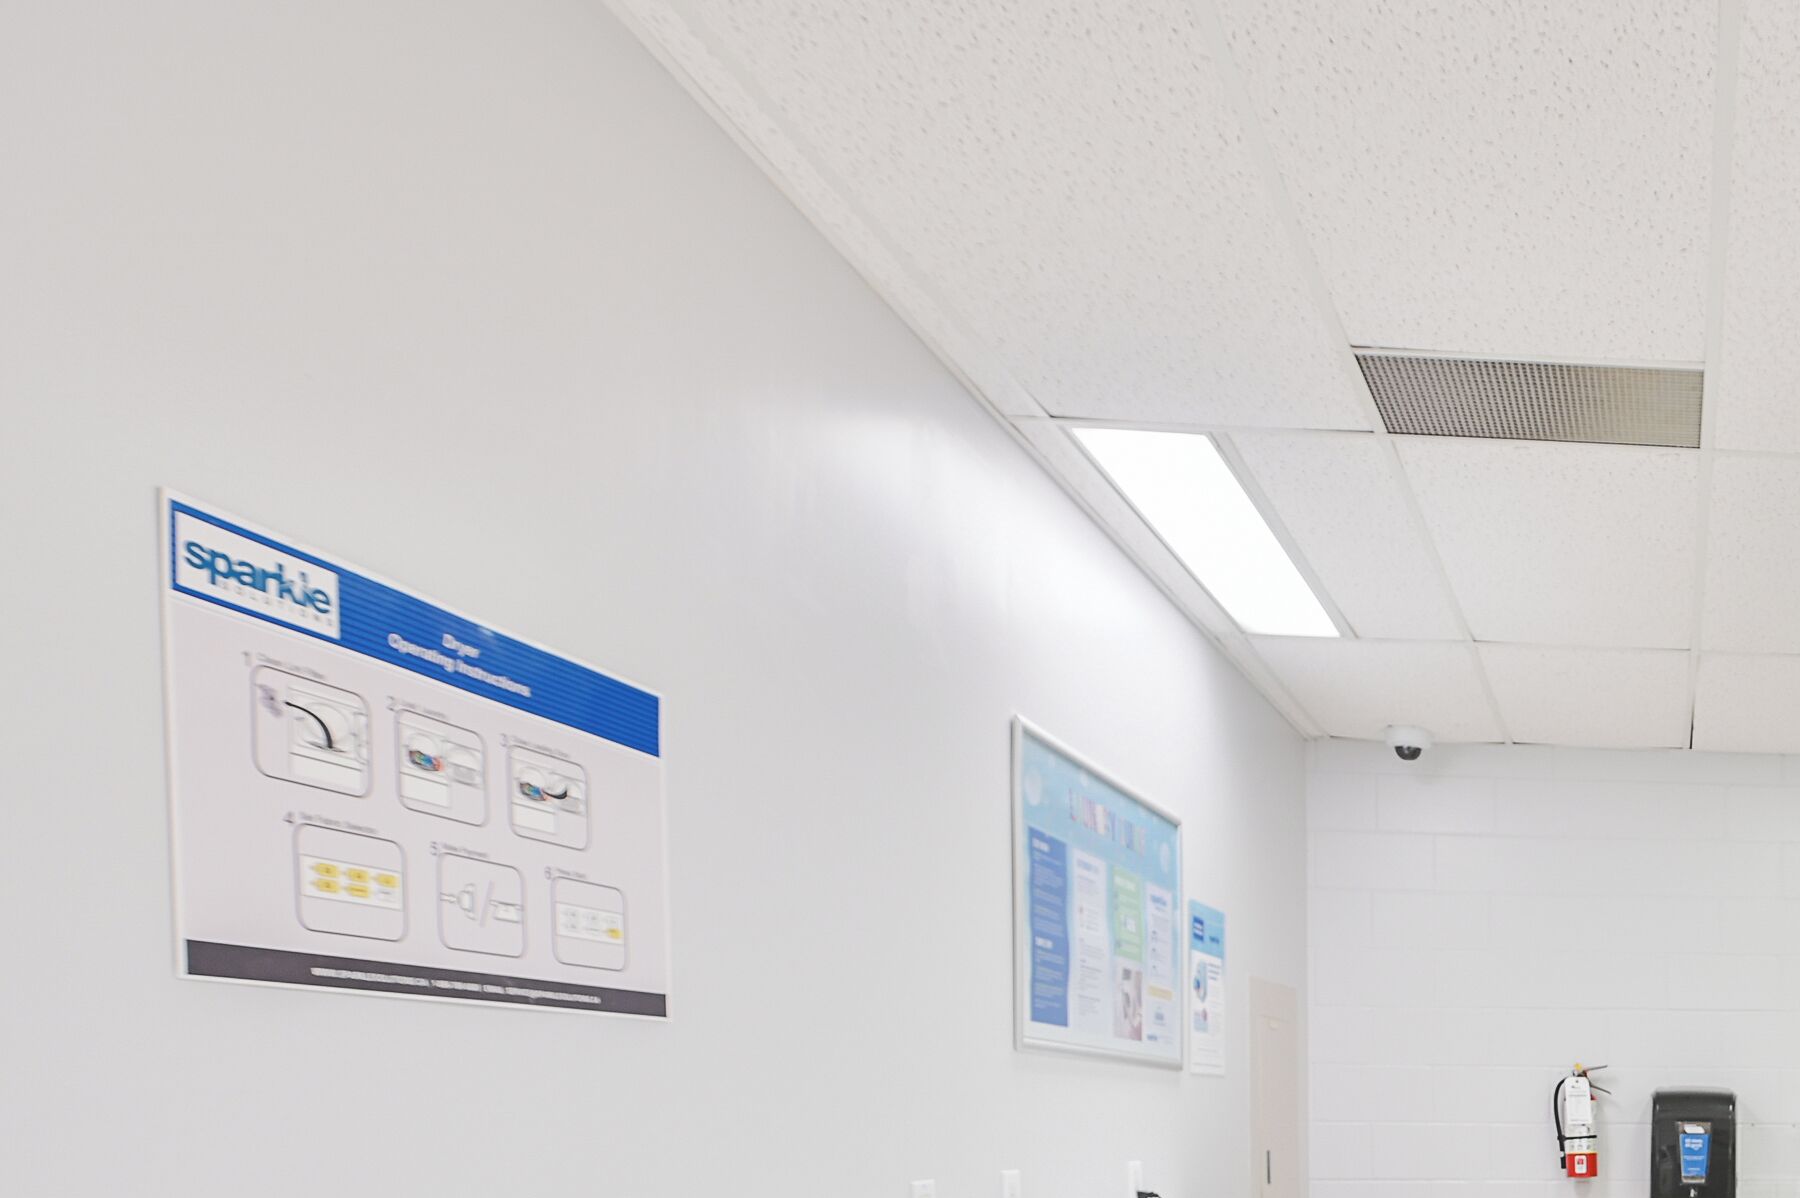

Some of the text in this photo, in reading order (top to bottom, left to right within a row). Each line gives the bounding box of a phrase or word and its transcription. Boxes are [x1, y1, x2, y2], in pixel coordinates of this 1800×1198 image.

[184, 541, 330, 614] sparkle
[388, 633, 532, 698] Operating Instructions
